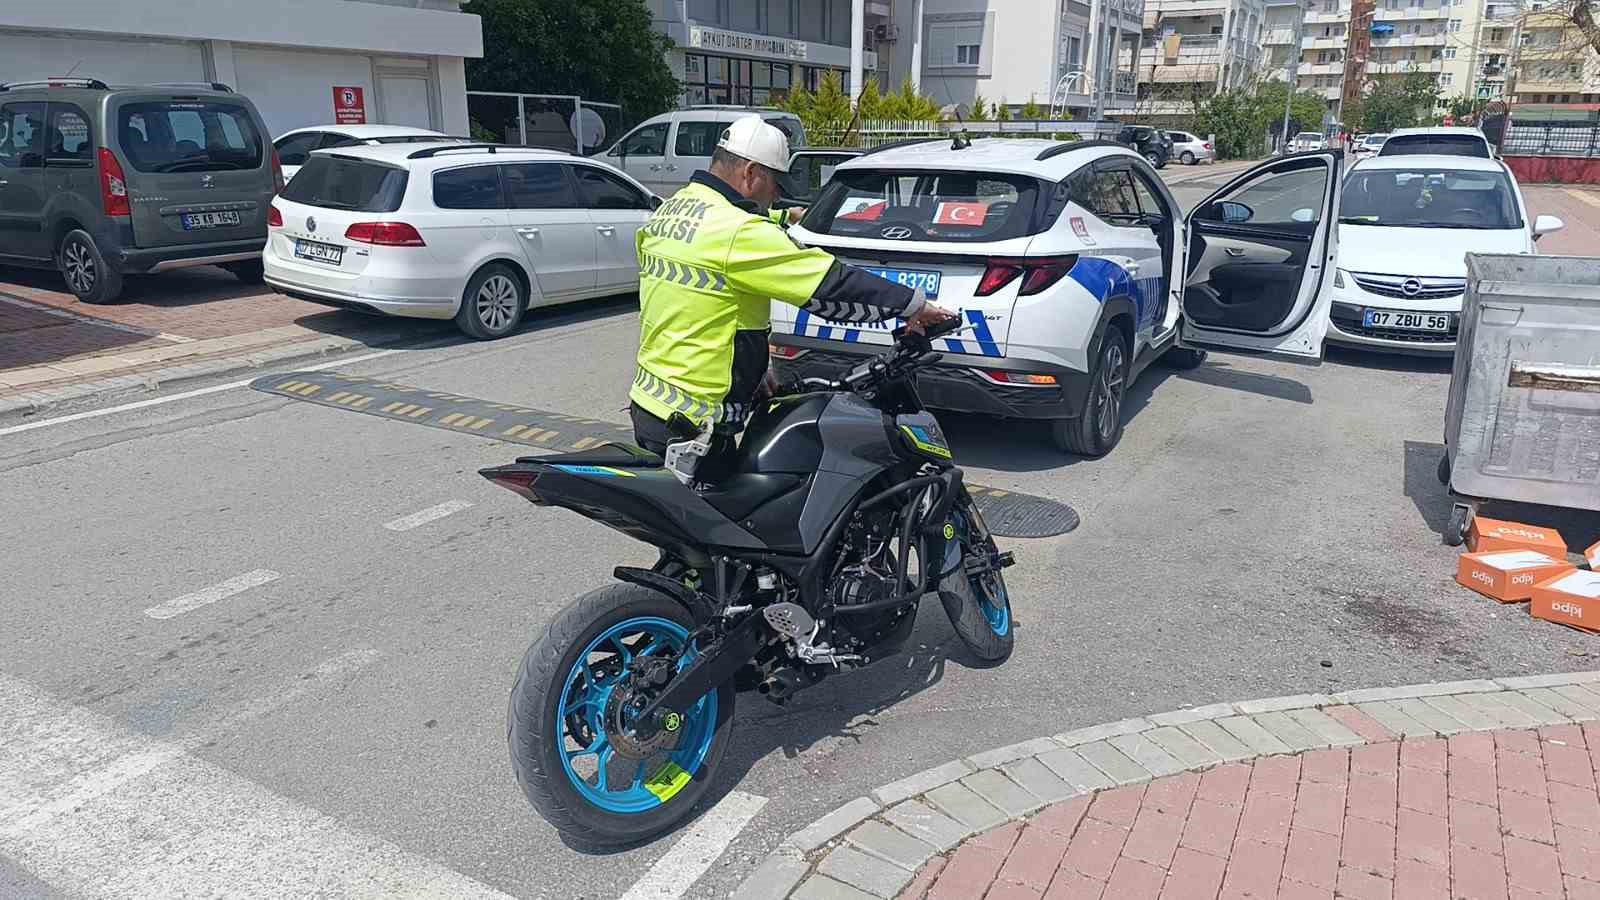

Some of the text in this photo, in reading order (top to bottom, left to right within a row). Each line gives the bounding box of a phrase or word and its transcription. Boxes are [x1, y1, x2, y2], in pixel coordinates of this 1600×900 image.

[189, 215, 200, 225] 35
[1372, 312, 1446, 329] 07 ZBU 56
[1552, 601, 1583, 619] kipa
